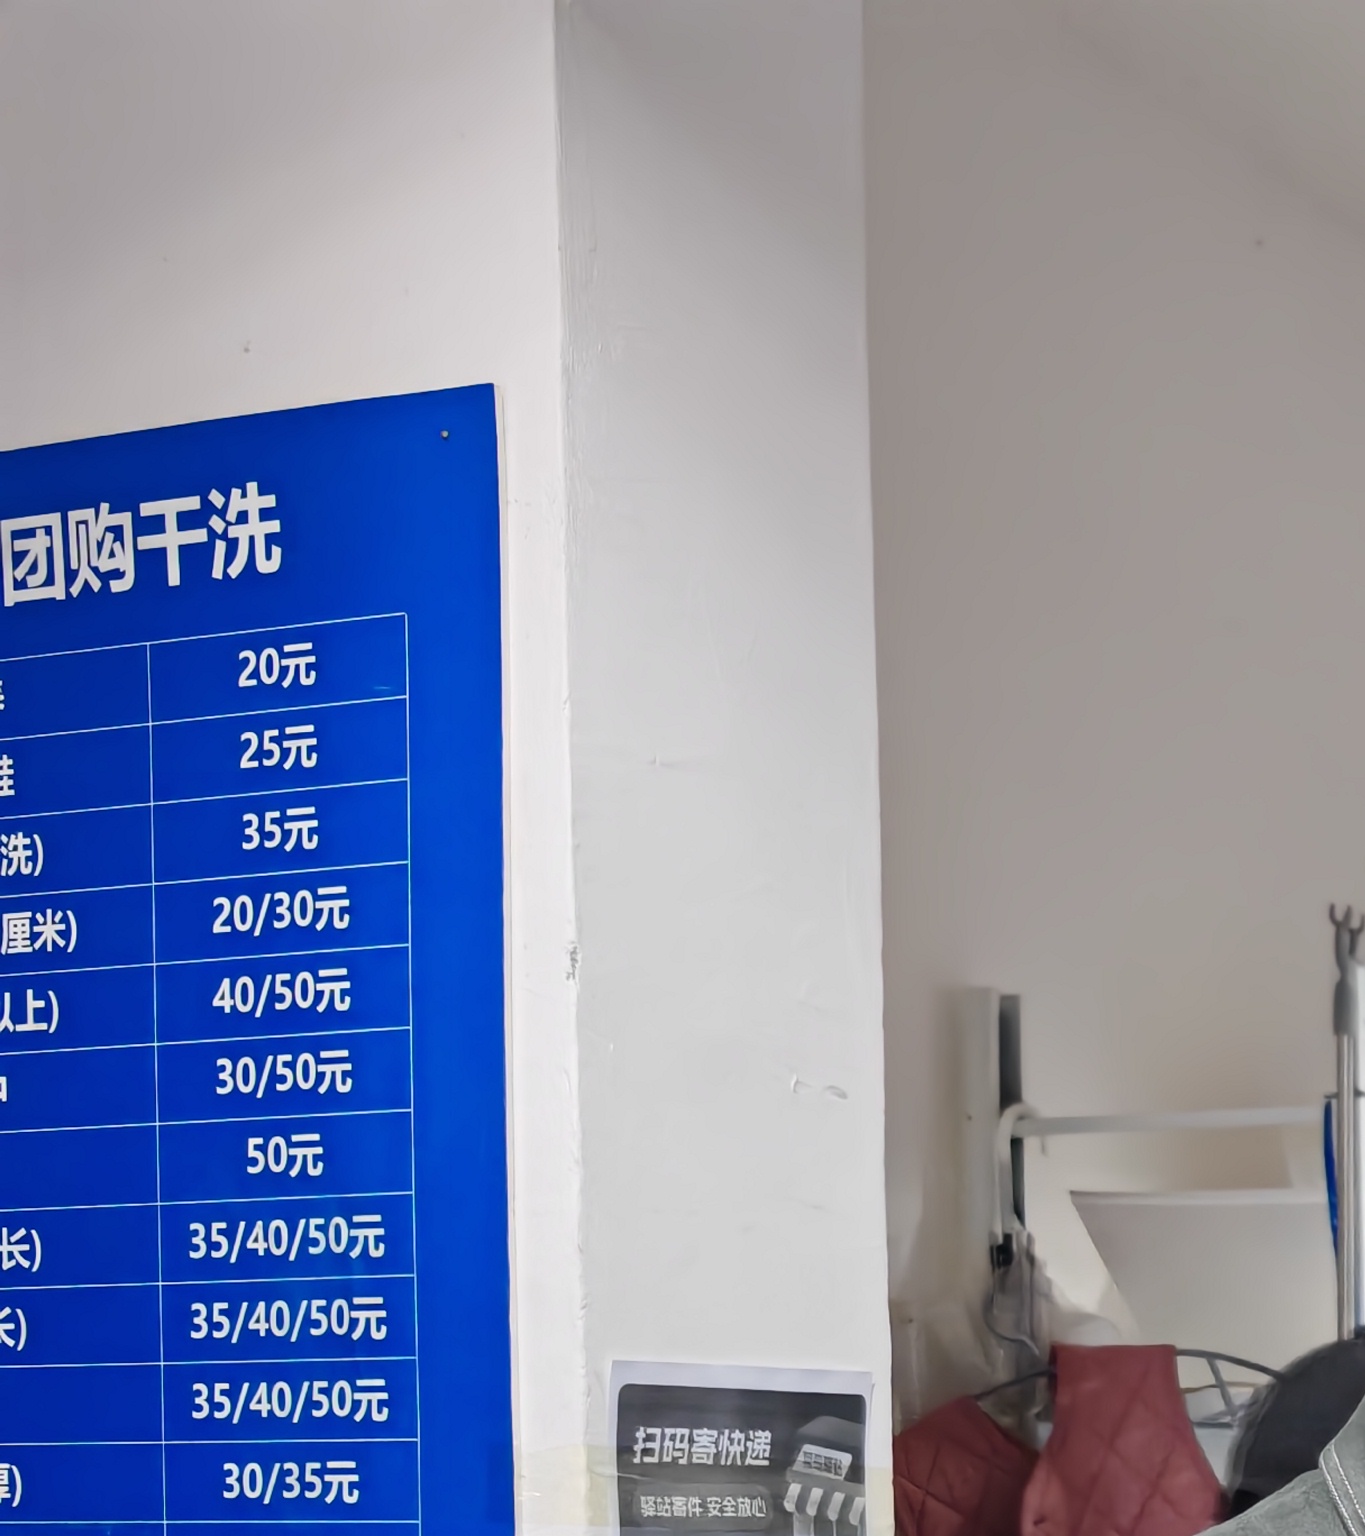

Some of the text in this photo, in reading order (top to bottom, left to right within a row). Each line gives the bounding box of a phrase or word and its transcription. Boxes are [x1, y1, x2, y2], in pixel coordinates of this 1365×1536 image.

[0, 482, 282, 606] 团购干洗
[239, 642, 316, 688] 20元
[240, 725, 317, 770] 25元
[242, 807, 318, 851] 35元
[1, 886, 349, 955] 厘米) 20/30元
[213, 968, 350, 1017] 40/50元
[216, 1050, 352, 1098] 30/50元
[247, 1134, 323, 1177] 50元
[189, 1215, 385, 1263] 35/40/50元
[191, 1297, 387, 1343] 35/40/50元
[192, 1379, 388, 1424] 35/40/50元
[633, 1426, 772, 1467] 扫码寄快递
[223, 1461, 359, 1504] 30/35元
